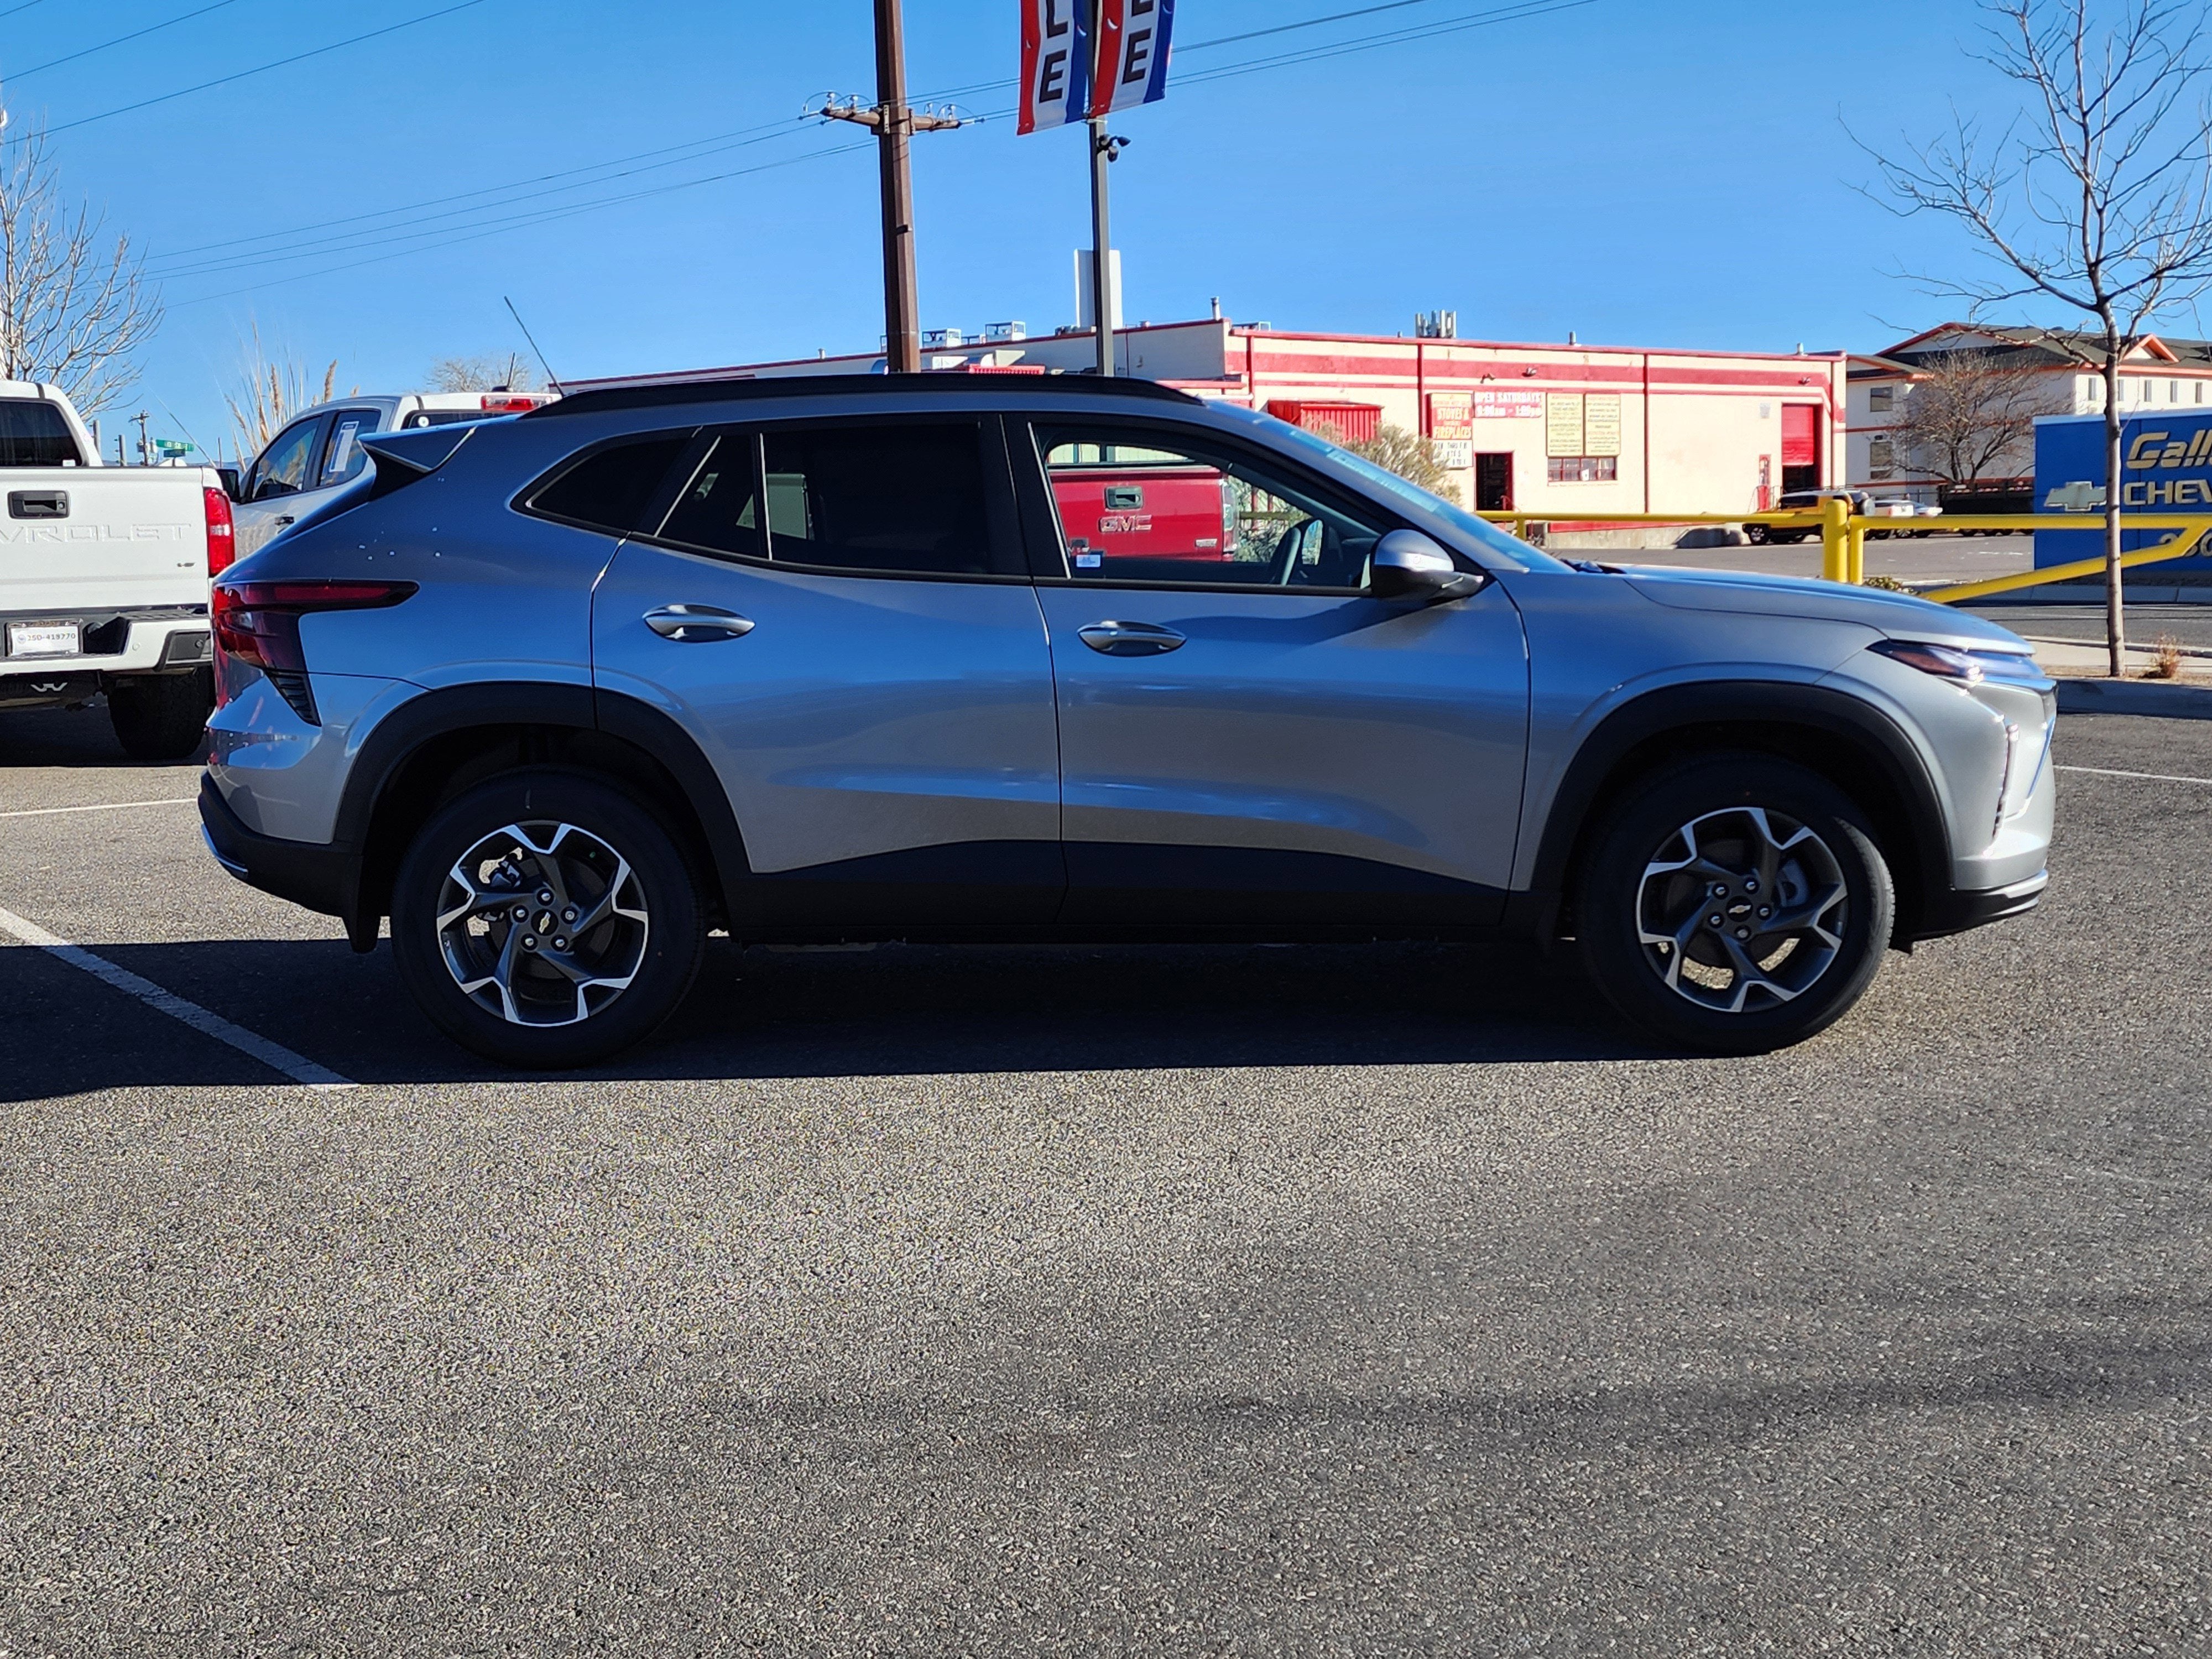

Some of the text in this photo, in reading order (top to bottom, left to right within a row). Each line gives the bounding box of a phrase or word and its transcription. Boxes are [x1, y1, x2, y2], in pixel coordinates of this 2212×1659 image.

[1475, 392, 1542, 404] OPEN SATURDAYS
[1437, 407, 1462, 420] STOVES
[1433, 426, 1472, 439] FIREPLACES
[1099, 514, 1152, 532] GMC
